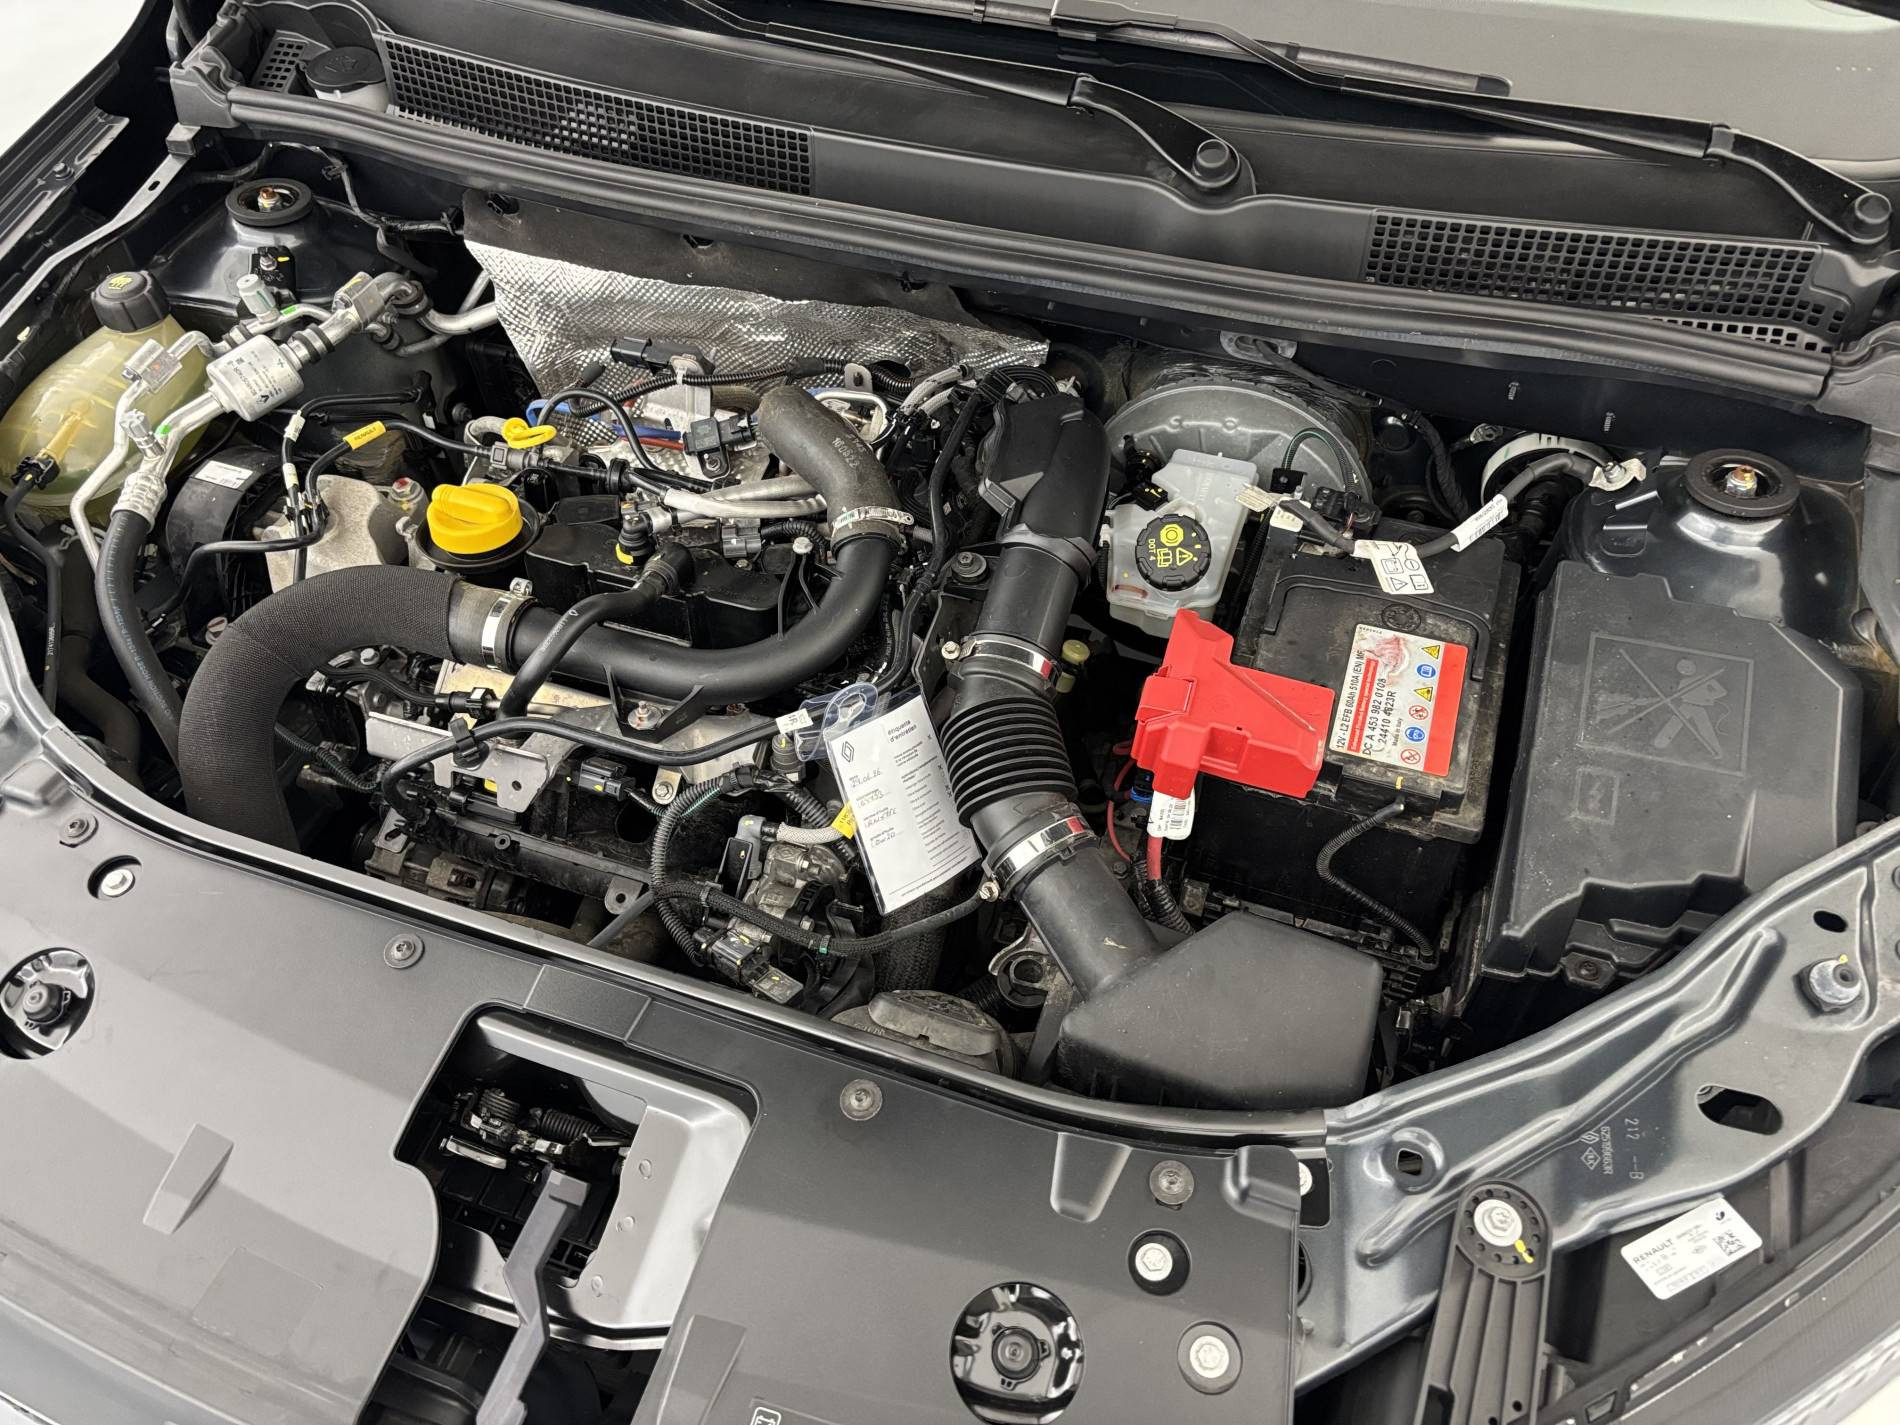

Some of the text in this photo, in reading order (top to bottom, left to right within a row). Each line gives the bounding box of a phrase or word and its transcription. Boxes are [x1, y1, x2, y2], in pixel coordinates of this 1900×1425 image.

[1148, 539, 1156, 553] DOT
[1353, 661, 1364, 674] (EN)
[1350, 675, 1360, 690] 510A
[1346, 691, 1356, 707] 60Ah
[1371, 700, 1382, 714] 982
[1342, 708, 1352, 722] EFB
[1341, 723, 1349, 731] L2
[1368, 716, 1378, 730] 453
[1378, 719, 1390, 744] 24410
[1336, 736, 1345, 749] 12V
[1391, 734, 1399, 746] Made
[1363, 743, 1372, 755] DC
[1632, 1239, 1673, 1264] RENAULT
